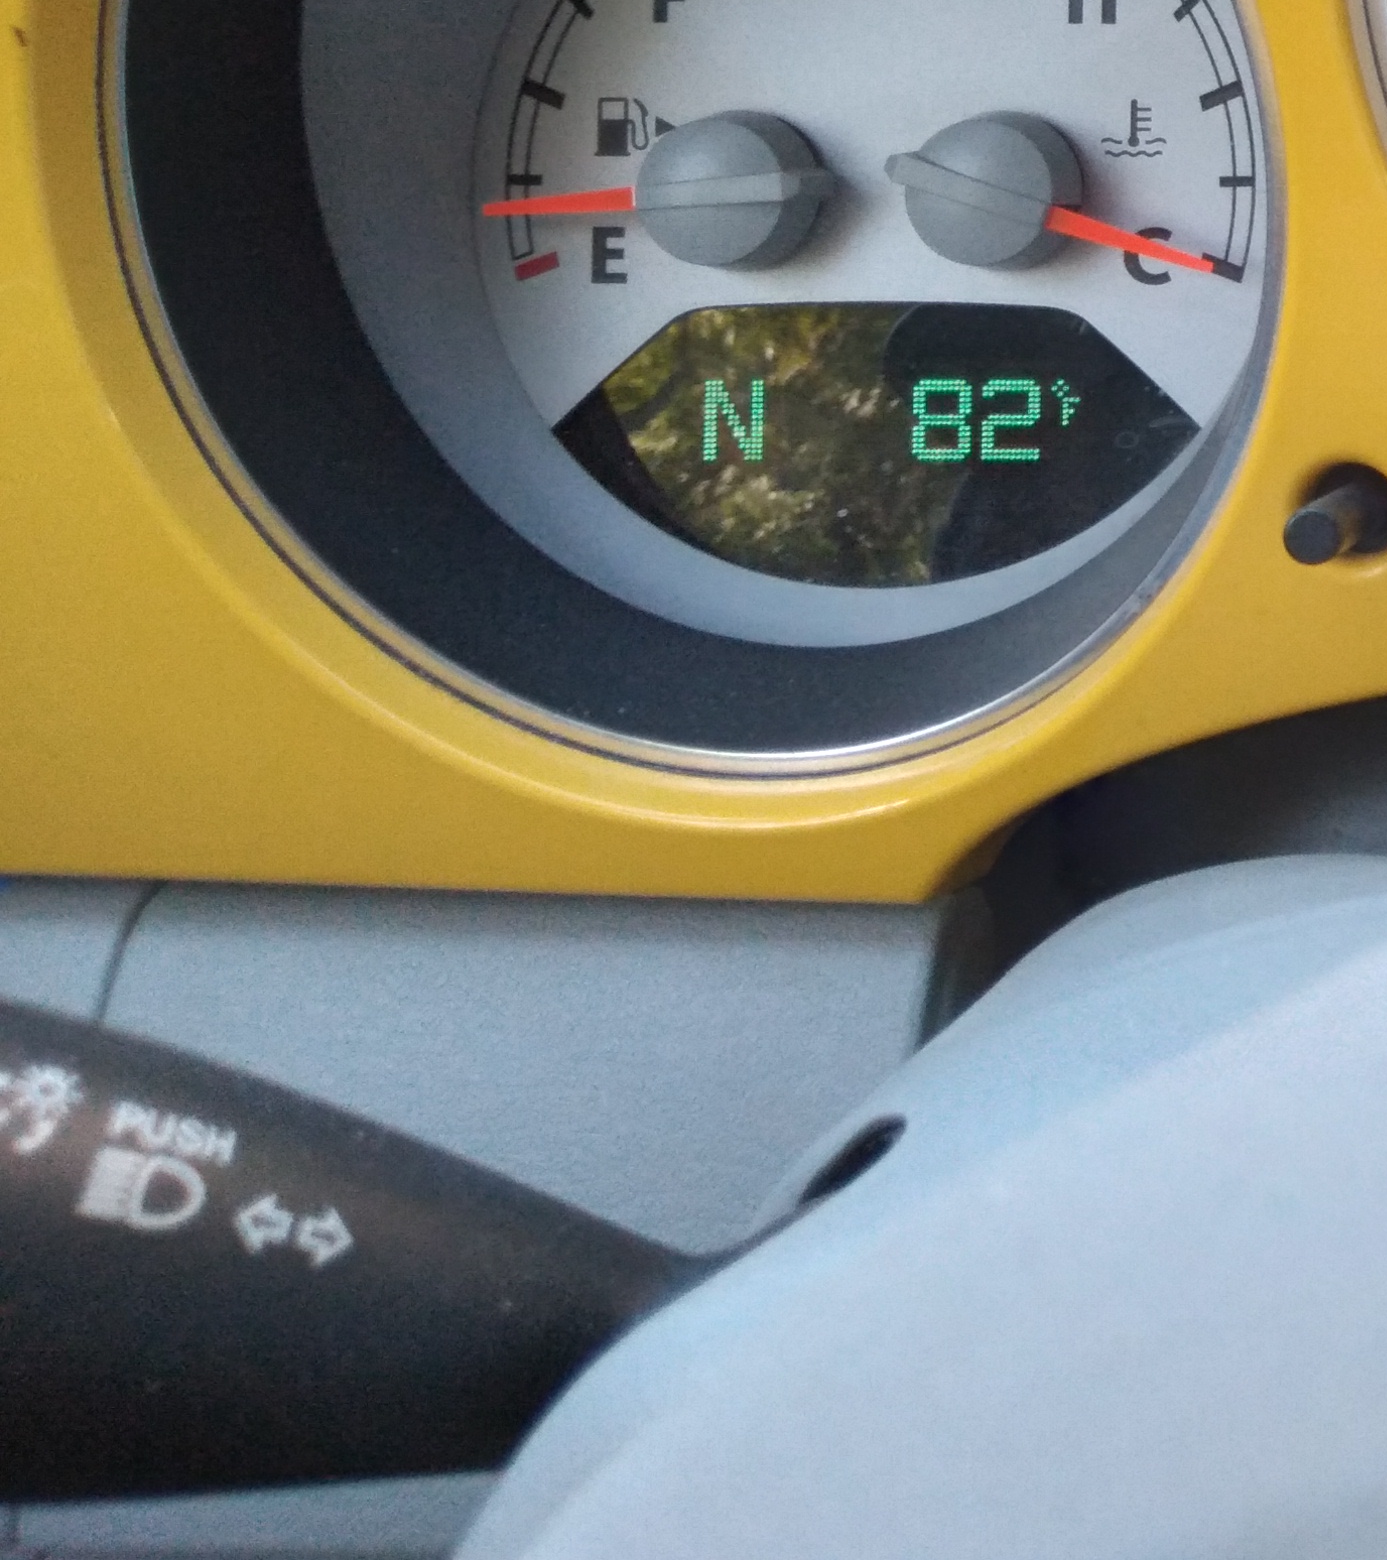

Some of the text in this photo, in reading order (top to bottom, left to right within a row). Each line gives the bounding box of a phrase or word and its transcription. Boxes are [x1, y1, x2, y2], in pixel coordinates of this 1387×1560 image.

[591, 226, 629, 284] E
[1122, 226, 1173, 285] C
[702, 378, 764, 462] N
[107, 1099, 238, 1167] PUSH
